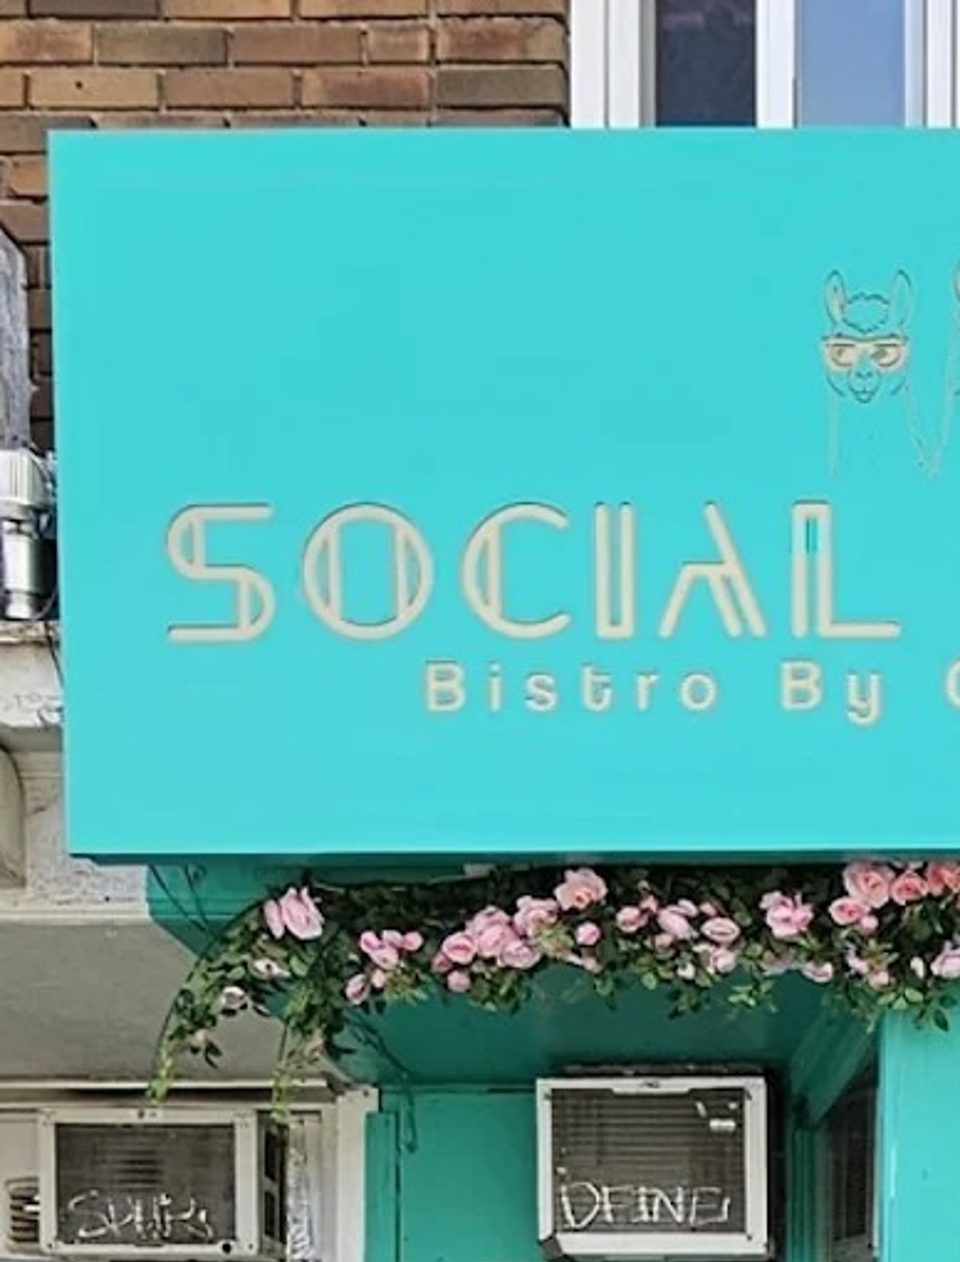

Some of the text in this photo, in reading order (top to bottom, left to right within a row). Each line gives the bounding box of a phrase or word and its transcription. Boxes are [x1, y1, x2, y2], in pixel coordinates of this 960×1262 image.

[165, 500, 902, 640] SOCIAL
[423, 659, 718, 713] Bistro
[780, 658, 881, 727] By
